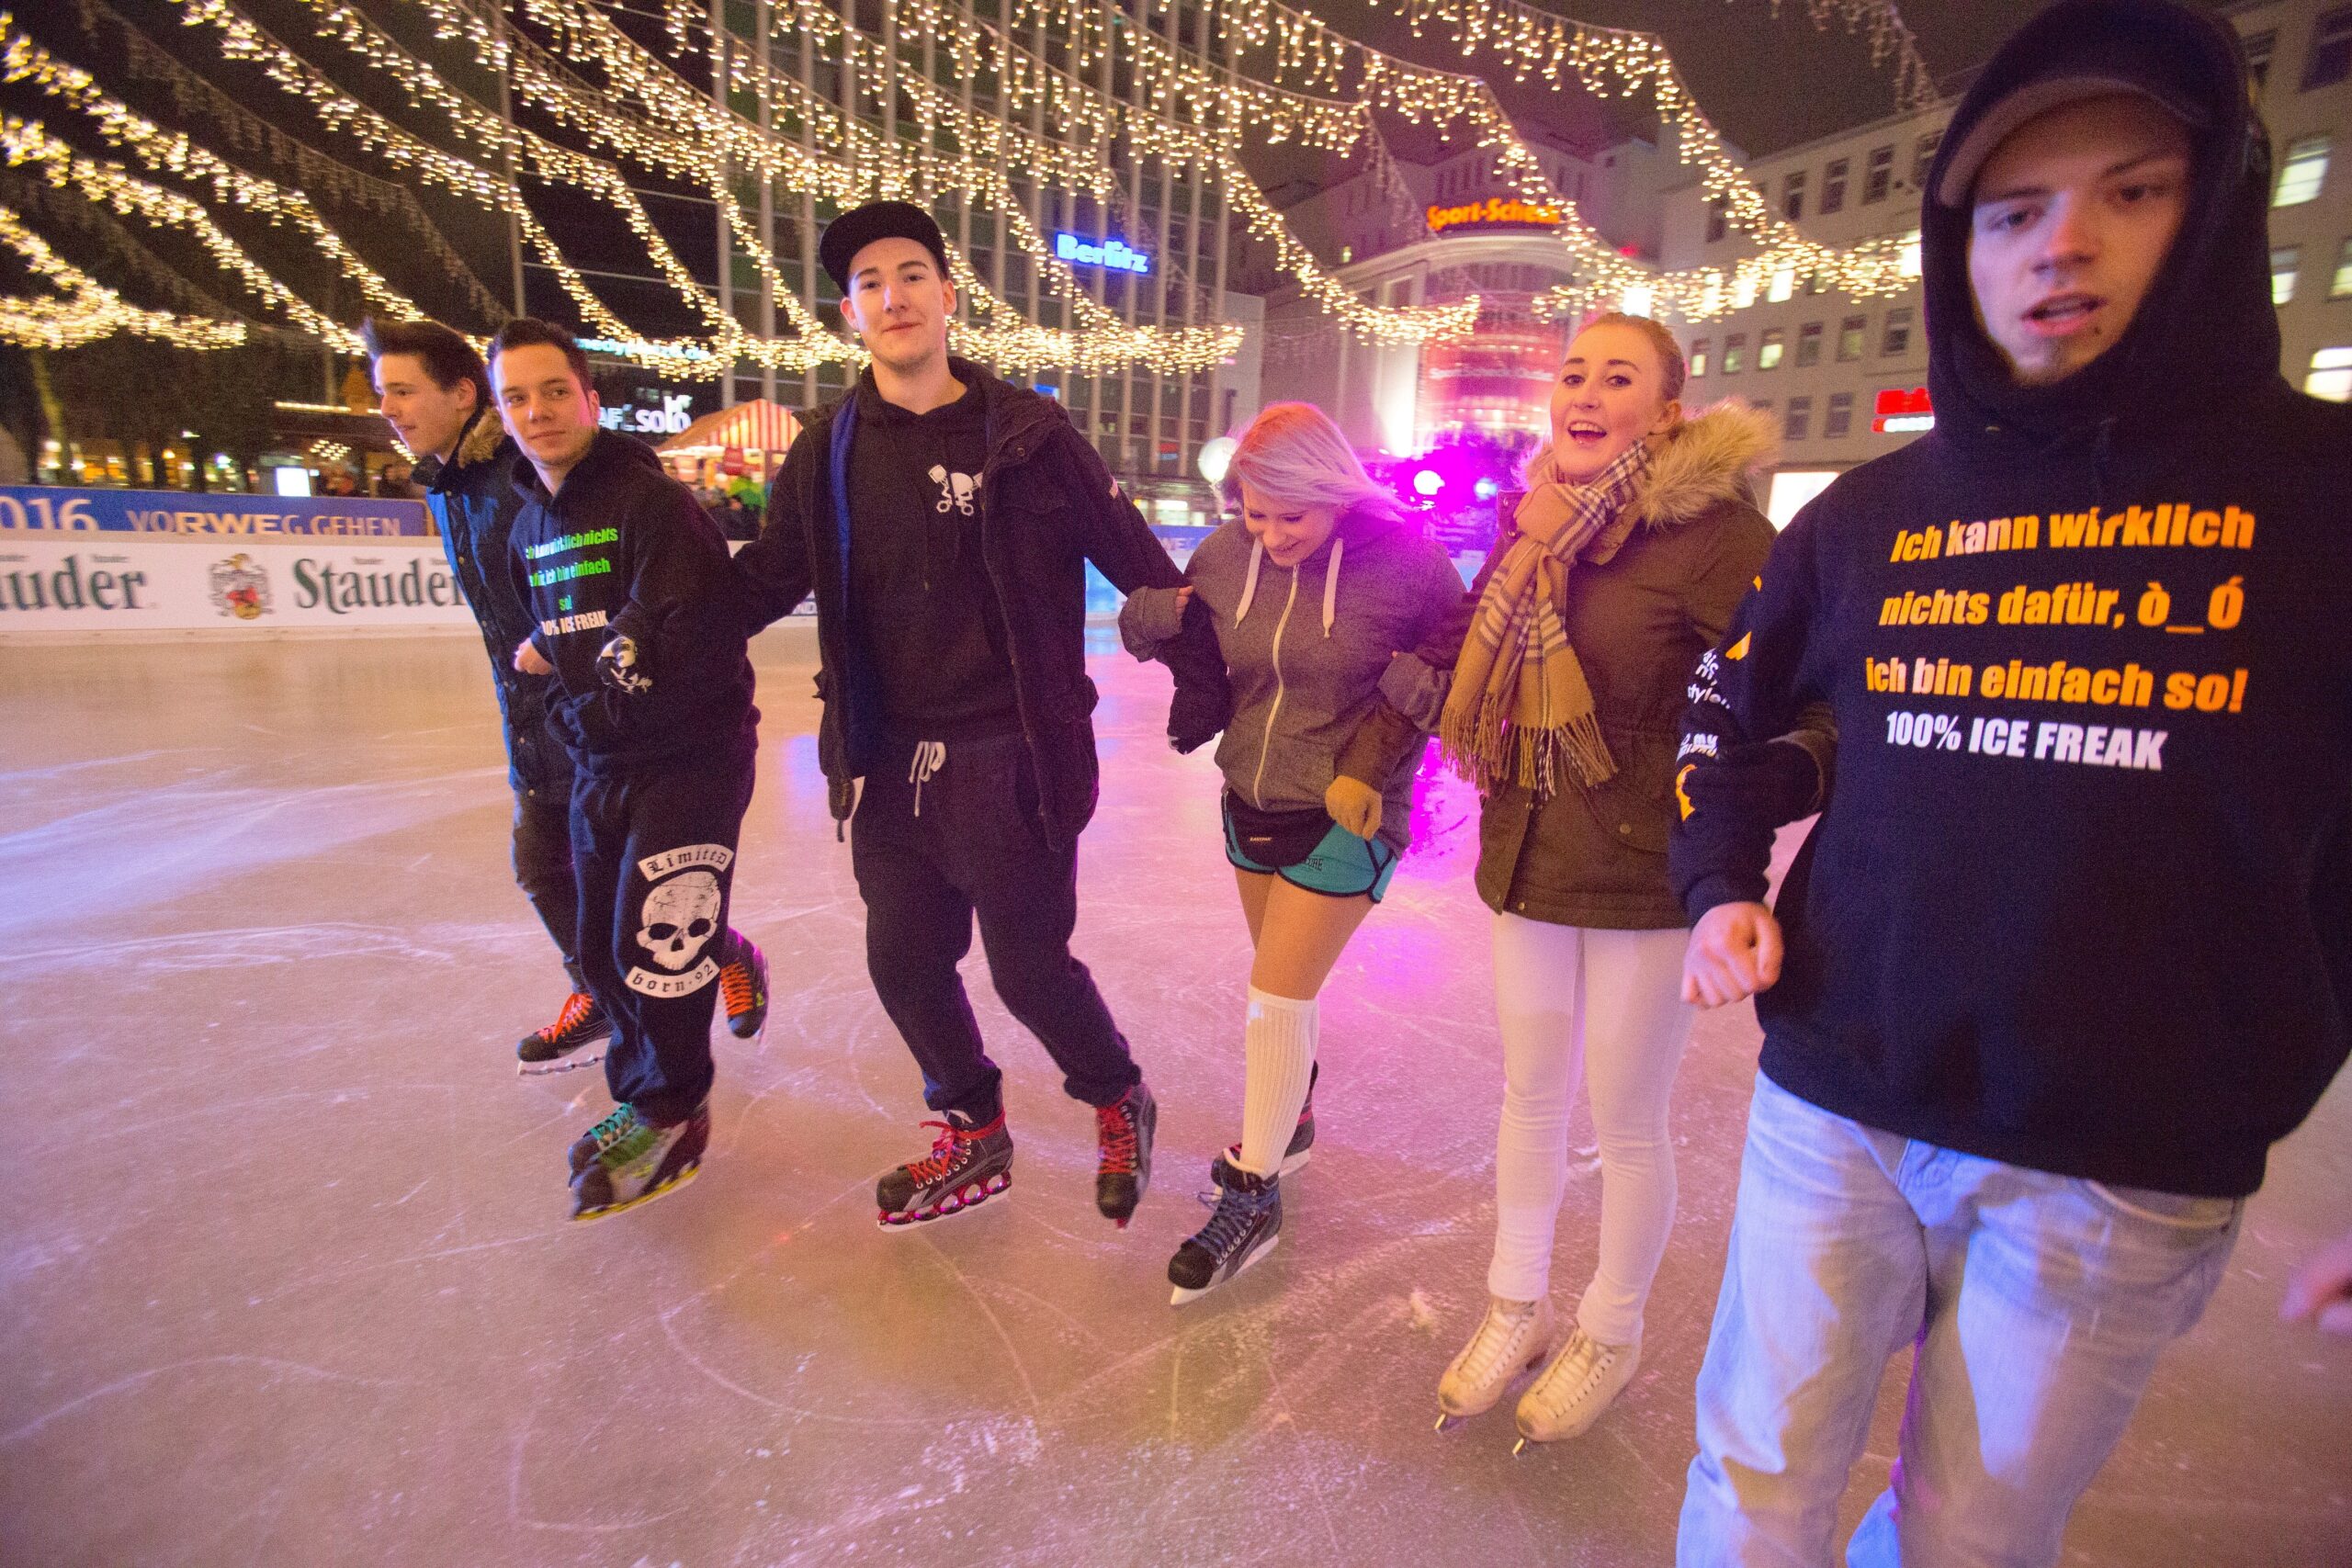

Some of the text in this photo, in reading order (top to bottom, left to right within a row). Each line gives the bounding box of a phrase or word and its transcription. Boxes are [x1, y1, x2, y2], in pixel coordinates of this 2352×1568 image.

[1057, 234, 1148, 273] Berlitz
[126, 511, 302, 536] VORWEG
[1890, 503, 2255, 563] Ich kann wirklich
[0, 554, 147, 610] uder
[1878, 586, 1989, 626] nichts
[1997, 581, 2125, 629] dafür,
[1912, 658, 1973, 696] bin
[1980, 660, 2154, 707] einfach
[2164, 668, 2248, 713] so!
[1886, 711, 2168, 771] 100% ICE FREAK
